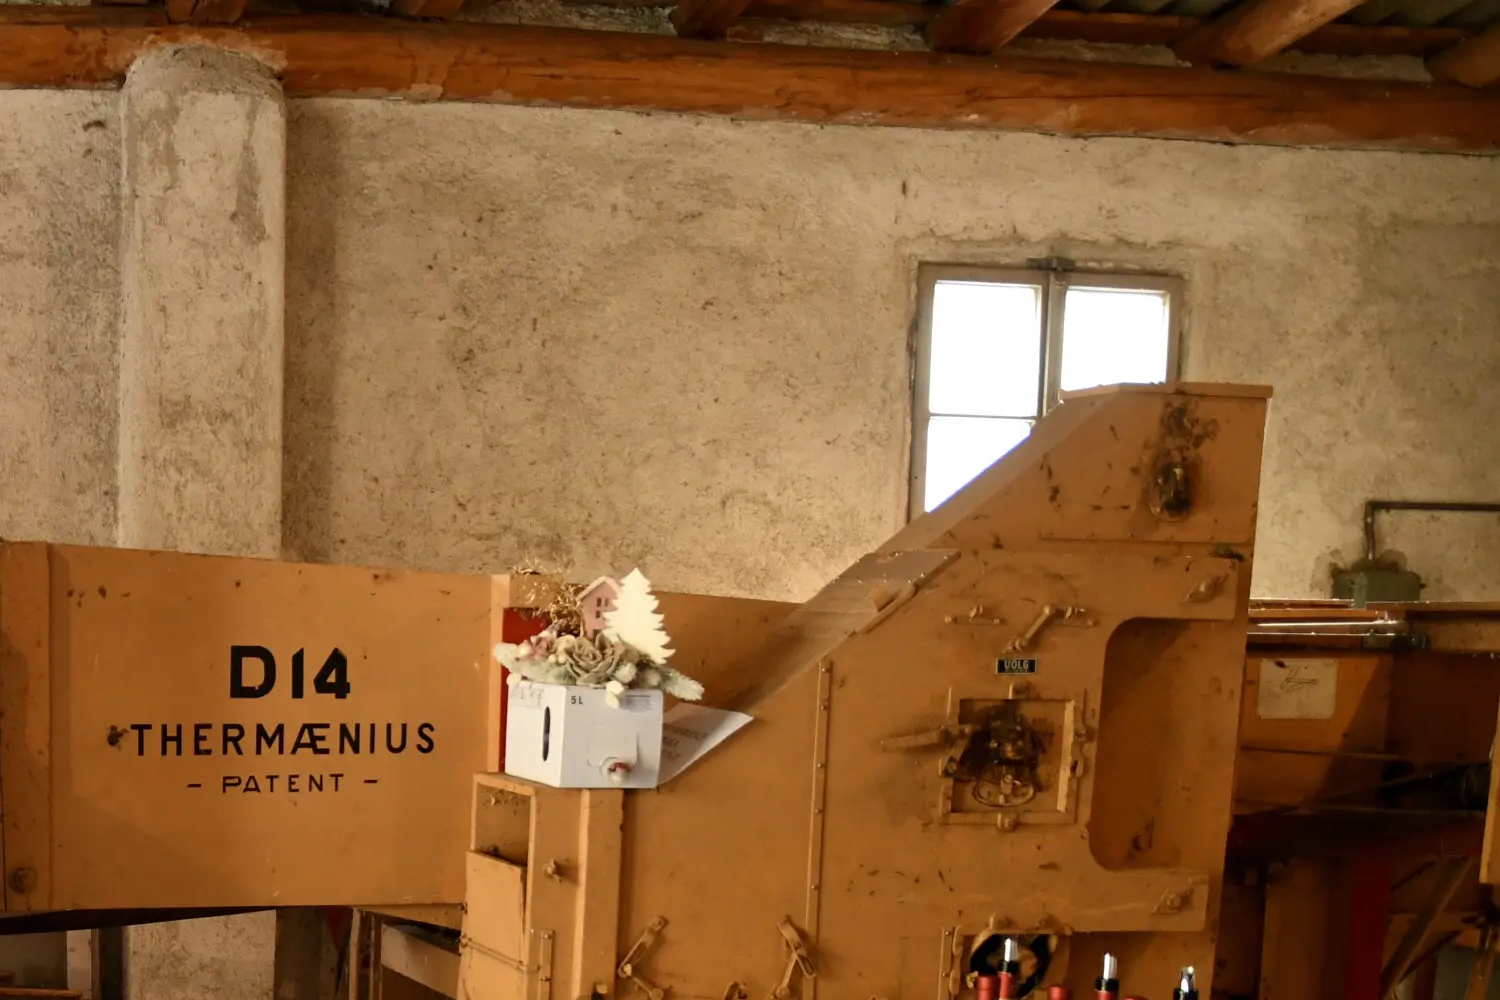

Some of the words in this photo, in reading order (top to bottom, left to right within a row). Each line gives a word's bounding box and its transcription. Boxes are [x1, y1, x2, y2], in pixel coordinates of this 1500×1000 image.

[230, 645, 351, 699] D14
[131, 722, 436, 757] THERMÆNIUS
[222, 774, 345, 794] PATENT
